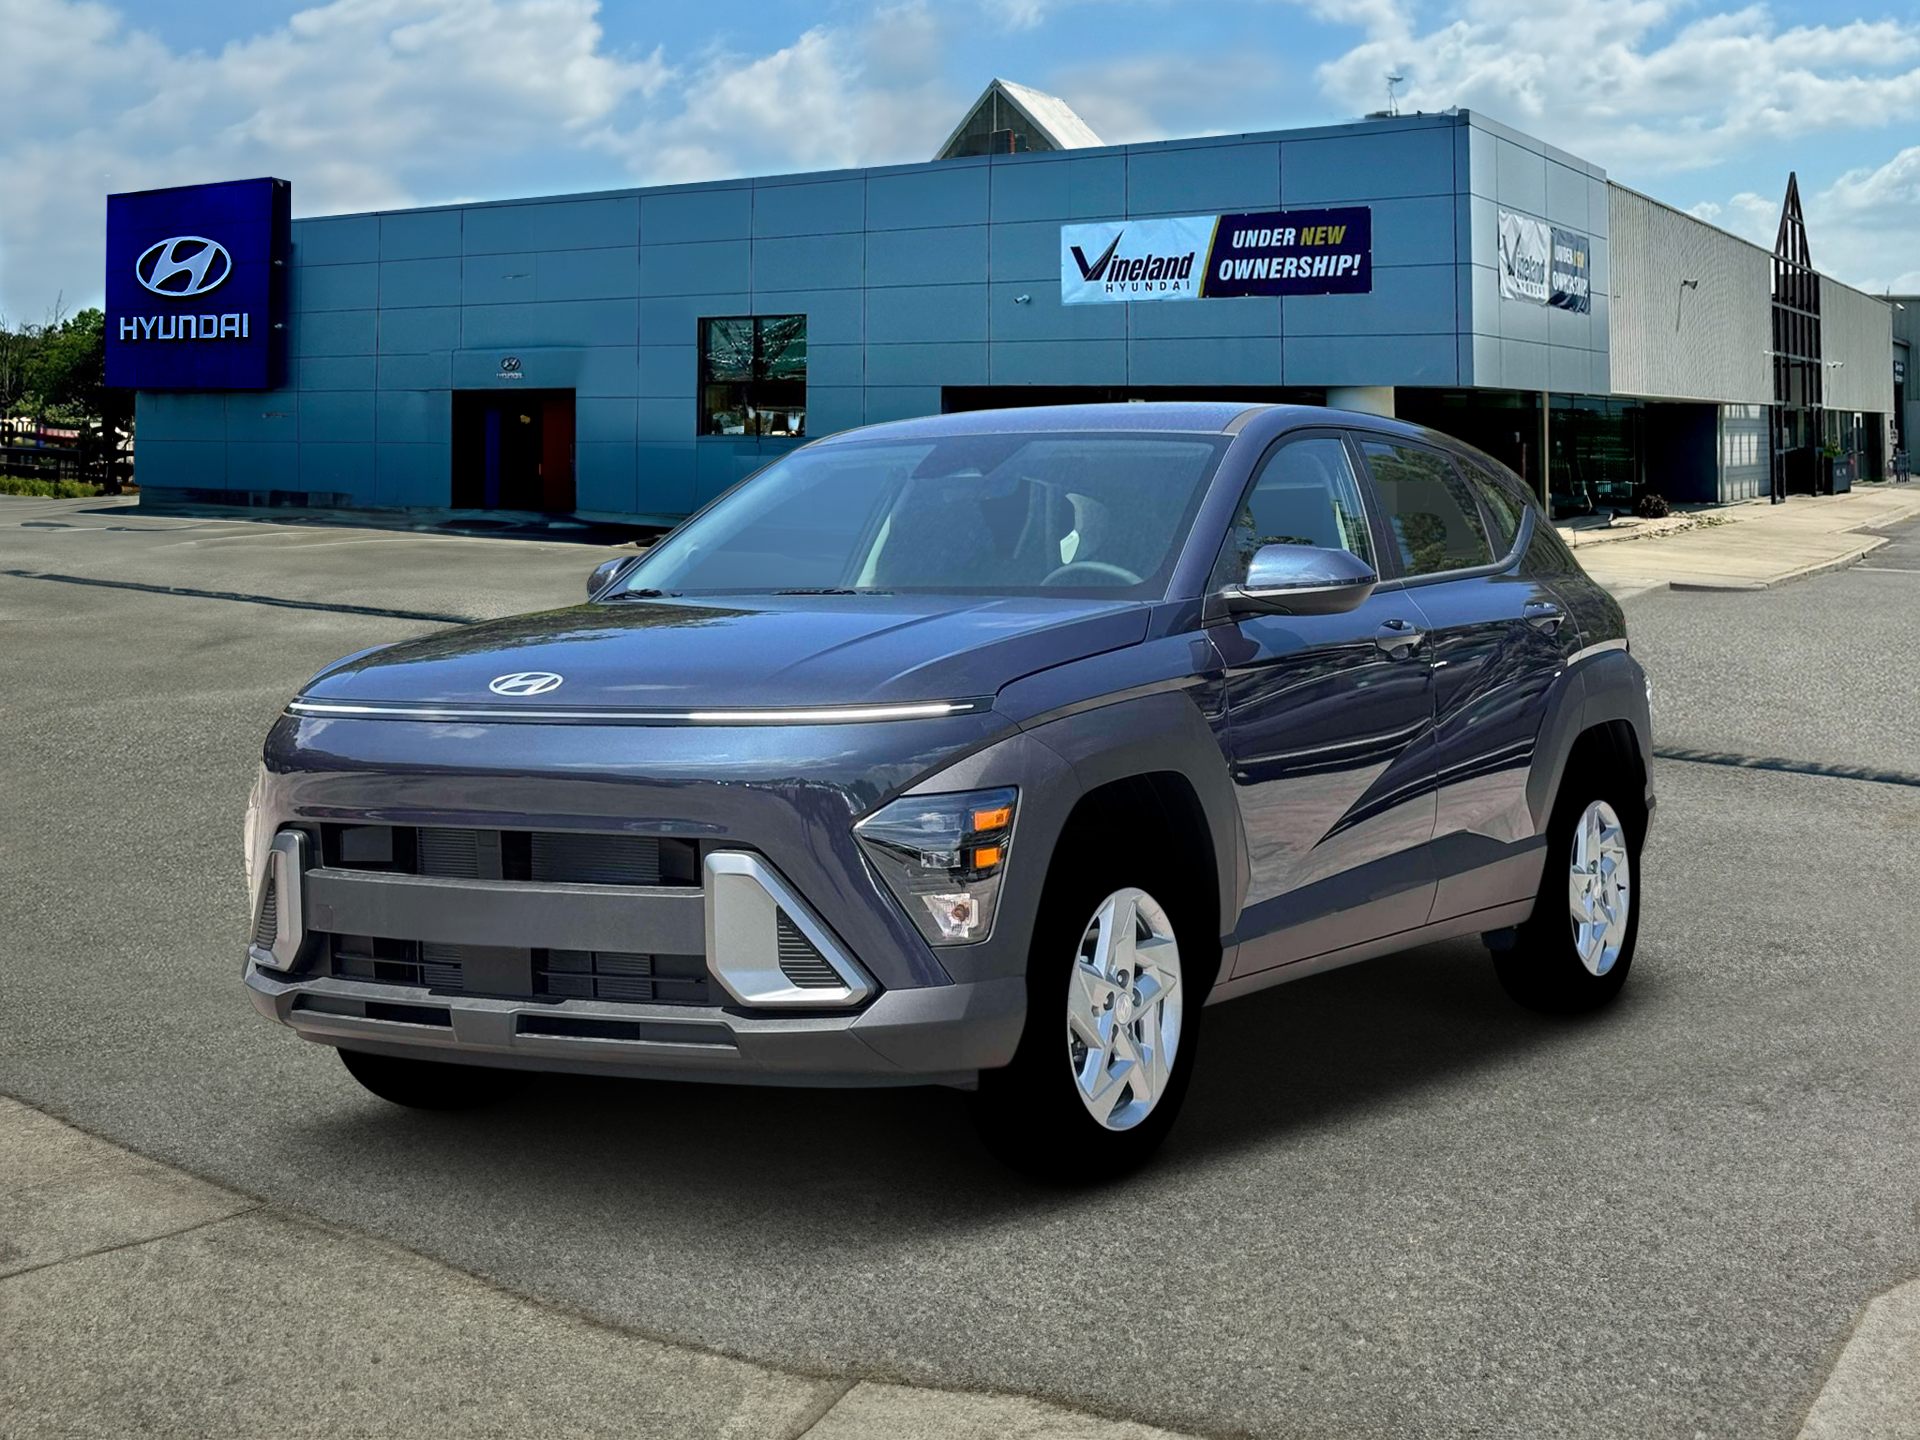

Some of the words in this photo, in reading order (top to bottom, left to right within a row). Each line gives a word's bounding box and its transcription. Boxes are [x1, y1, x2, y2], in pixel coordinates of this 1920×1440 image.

[1232, 228, 1297, 249] UNDER
[1300, 225, 1347, 246] NEW
[1070, 229, 1196, 282] Vineland
[1218, 254, 1362, 281] OWNERSHIP!
[1105, 280, 1190, 293] HYUNDAI
[119, 312, 249, 341] HYUNDAI
